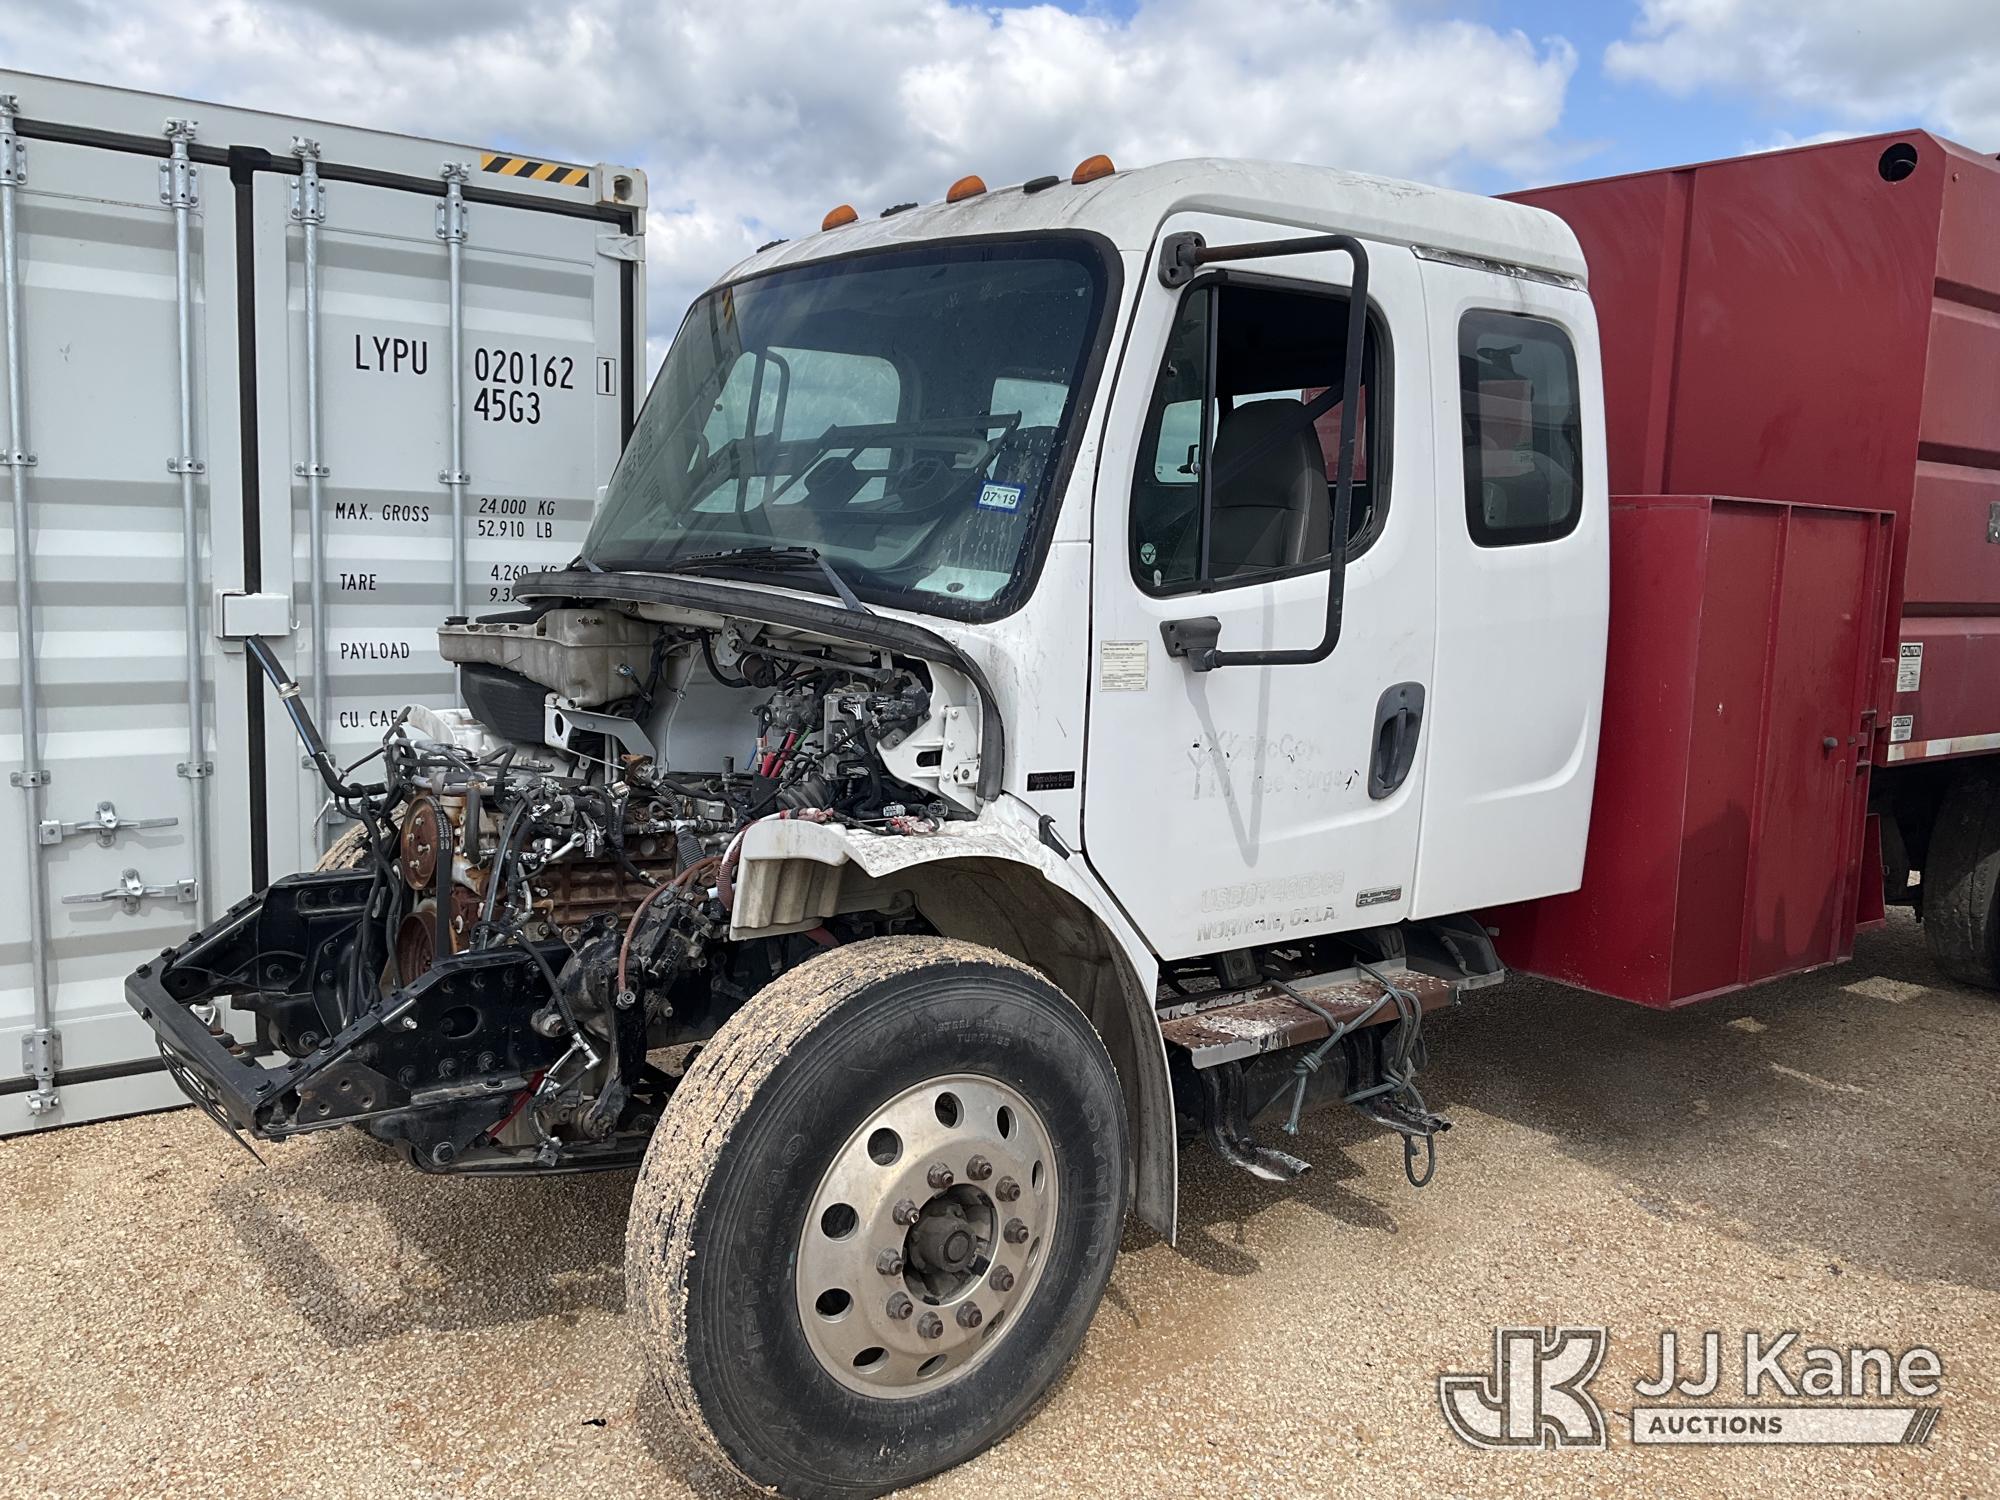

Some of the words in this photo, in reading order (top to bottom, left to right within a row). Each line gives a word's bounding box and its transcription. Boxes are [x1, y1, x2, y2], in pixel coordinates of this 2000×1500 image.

[355, 334, 428, 375] LYPU
[474, 347, 574, 390] 020162
[473, 387, 541, 424] 45G3
[982, 490, 998, 502] 07
[1003, 493, 1017, 505] 19
[335, 502, 373, 520] MAX.
[382, 504, 430, 522] GROSS
[478, 497, 527, 515] 24.000
[537, 500, 556, 516] KG
[477, 519, 525, 537] 52.910
[536, 522, 553, 538] LB
[340, 573, 377, 591] TARE
[340, 642, 410, 660] PAYLOAD
[339, 711, 365, 728] CU.
